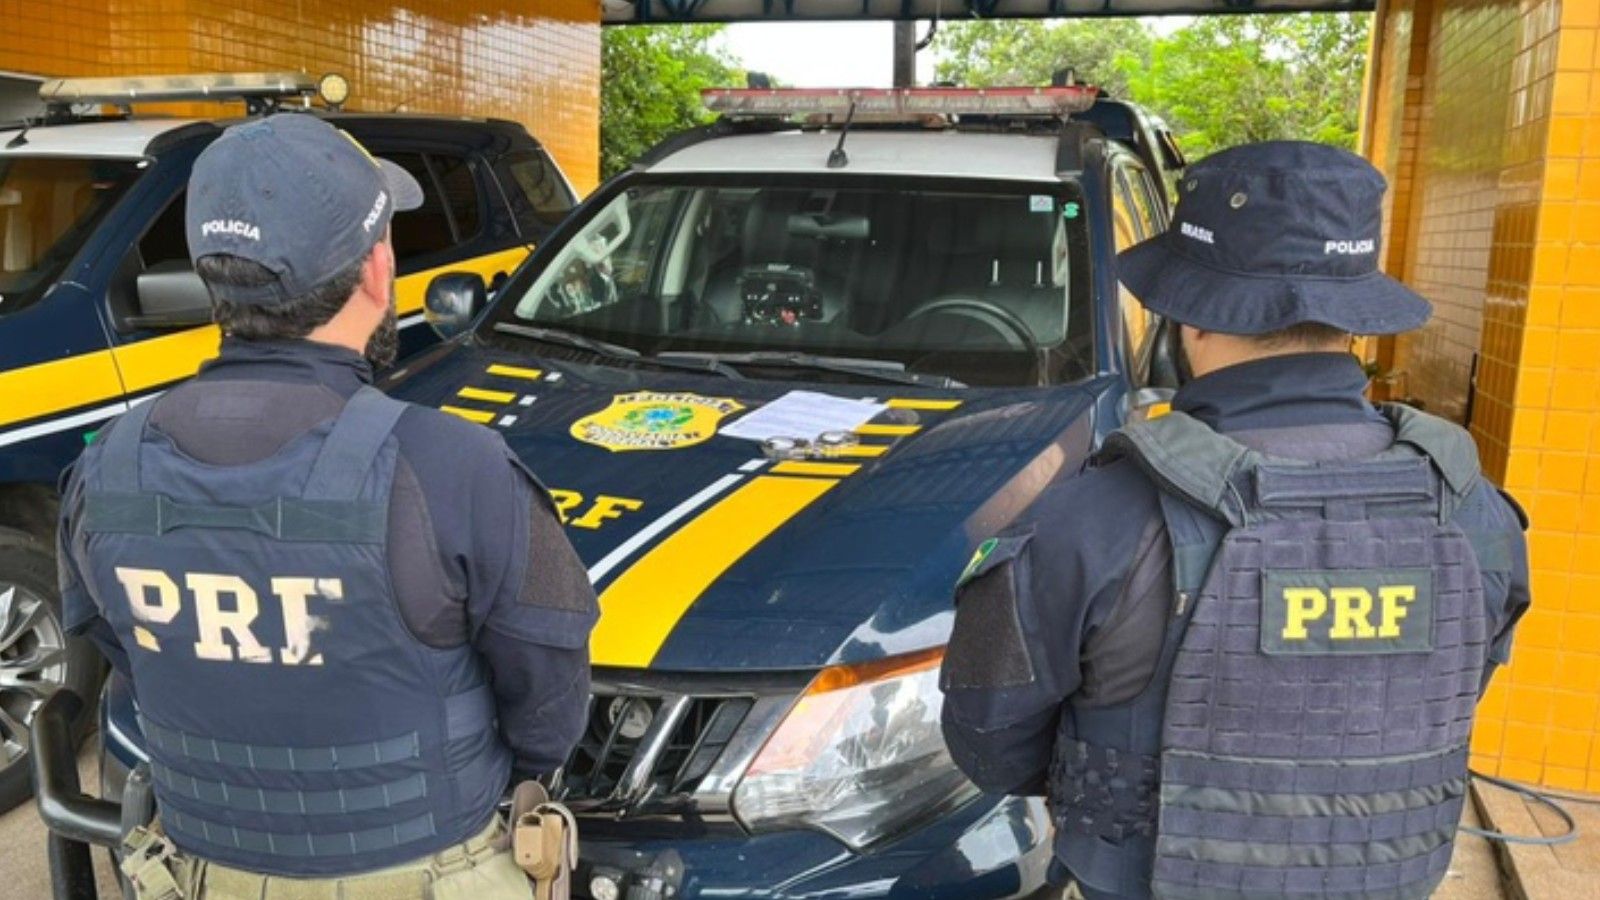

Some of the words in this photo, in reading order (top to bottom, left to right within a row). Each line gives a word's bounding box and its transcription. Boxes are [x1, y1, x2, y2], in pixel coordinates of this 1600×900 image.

[201, 219, 261, 241] POLICIA
[547, 488, 644, 529] RF
[114, 566, 343, 664] PRF
[1282, 585, 1416, 639] PRF
